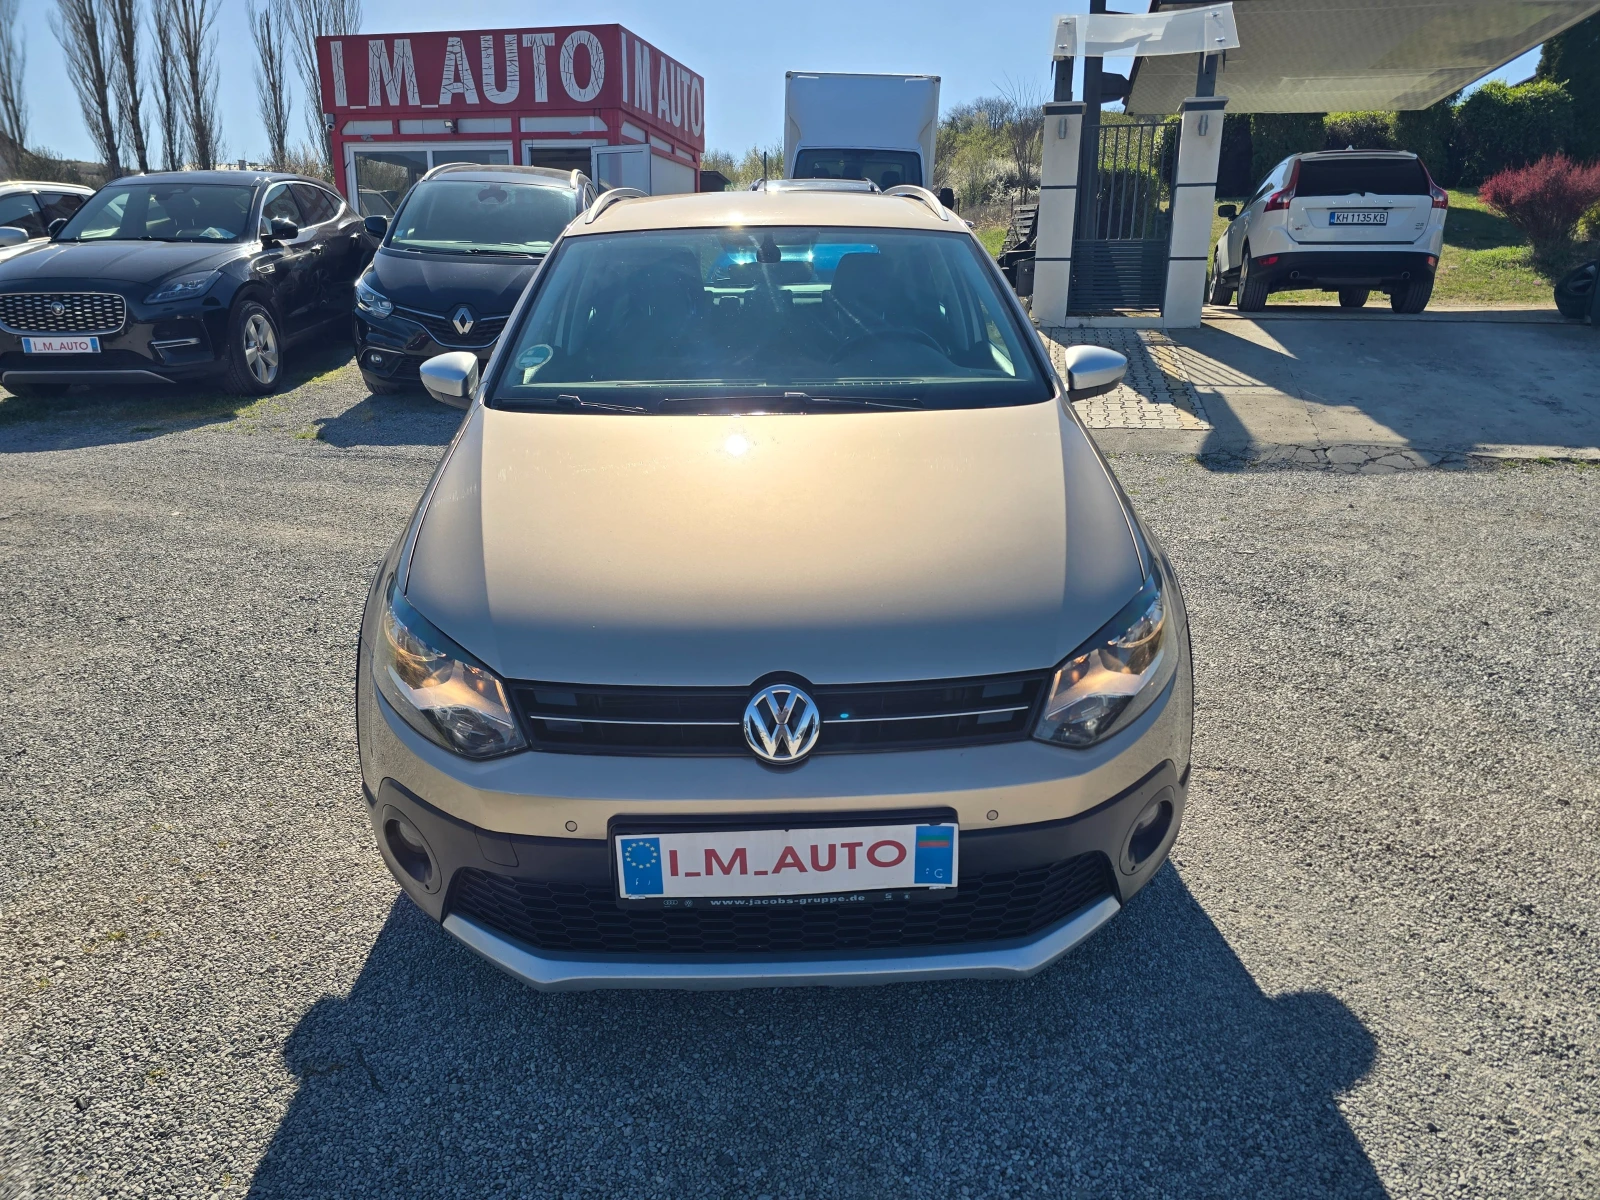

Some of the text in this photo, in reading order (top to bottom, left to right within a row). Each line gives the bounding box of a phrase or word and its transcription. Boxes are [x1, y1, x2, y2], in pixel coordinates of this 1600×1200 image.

[329, 30, 605, 110] I_M_AUTO
[634, 39, 653, 115] M
[657, 55, 702, 138] AUTO
[1336, 213, 1386, 223] KH 1135 KB
[33, 341, 88, 351] I_M_AUTO
[668, 839, 907, 878] I_M_AUTO
[710, 894, 866, 906] www.jacobs-gruppe.de
